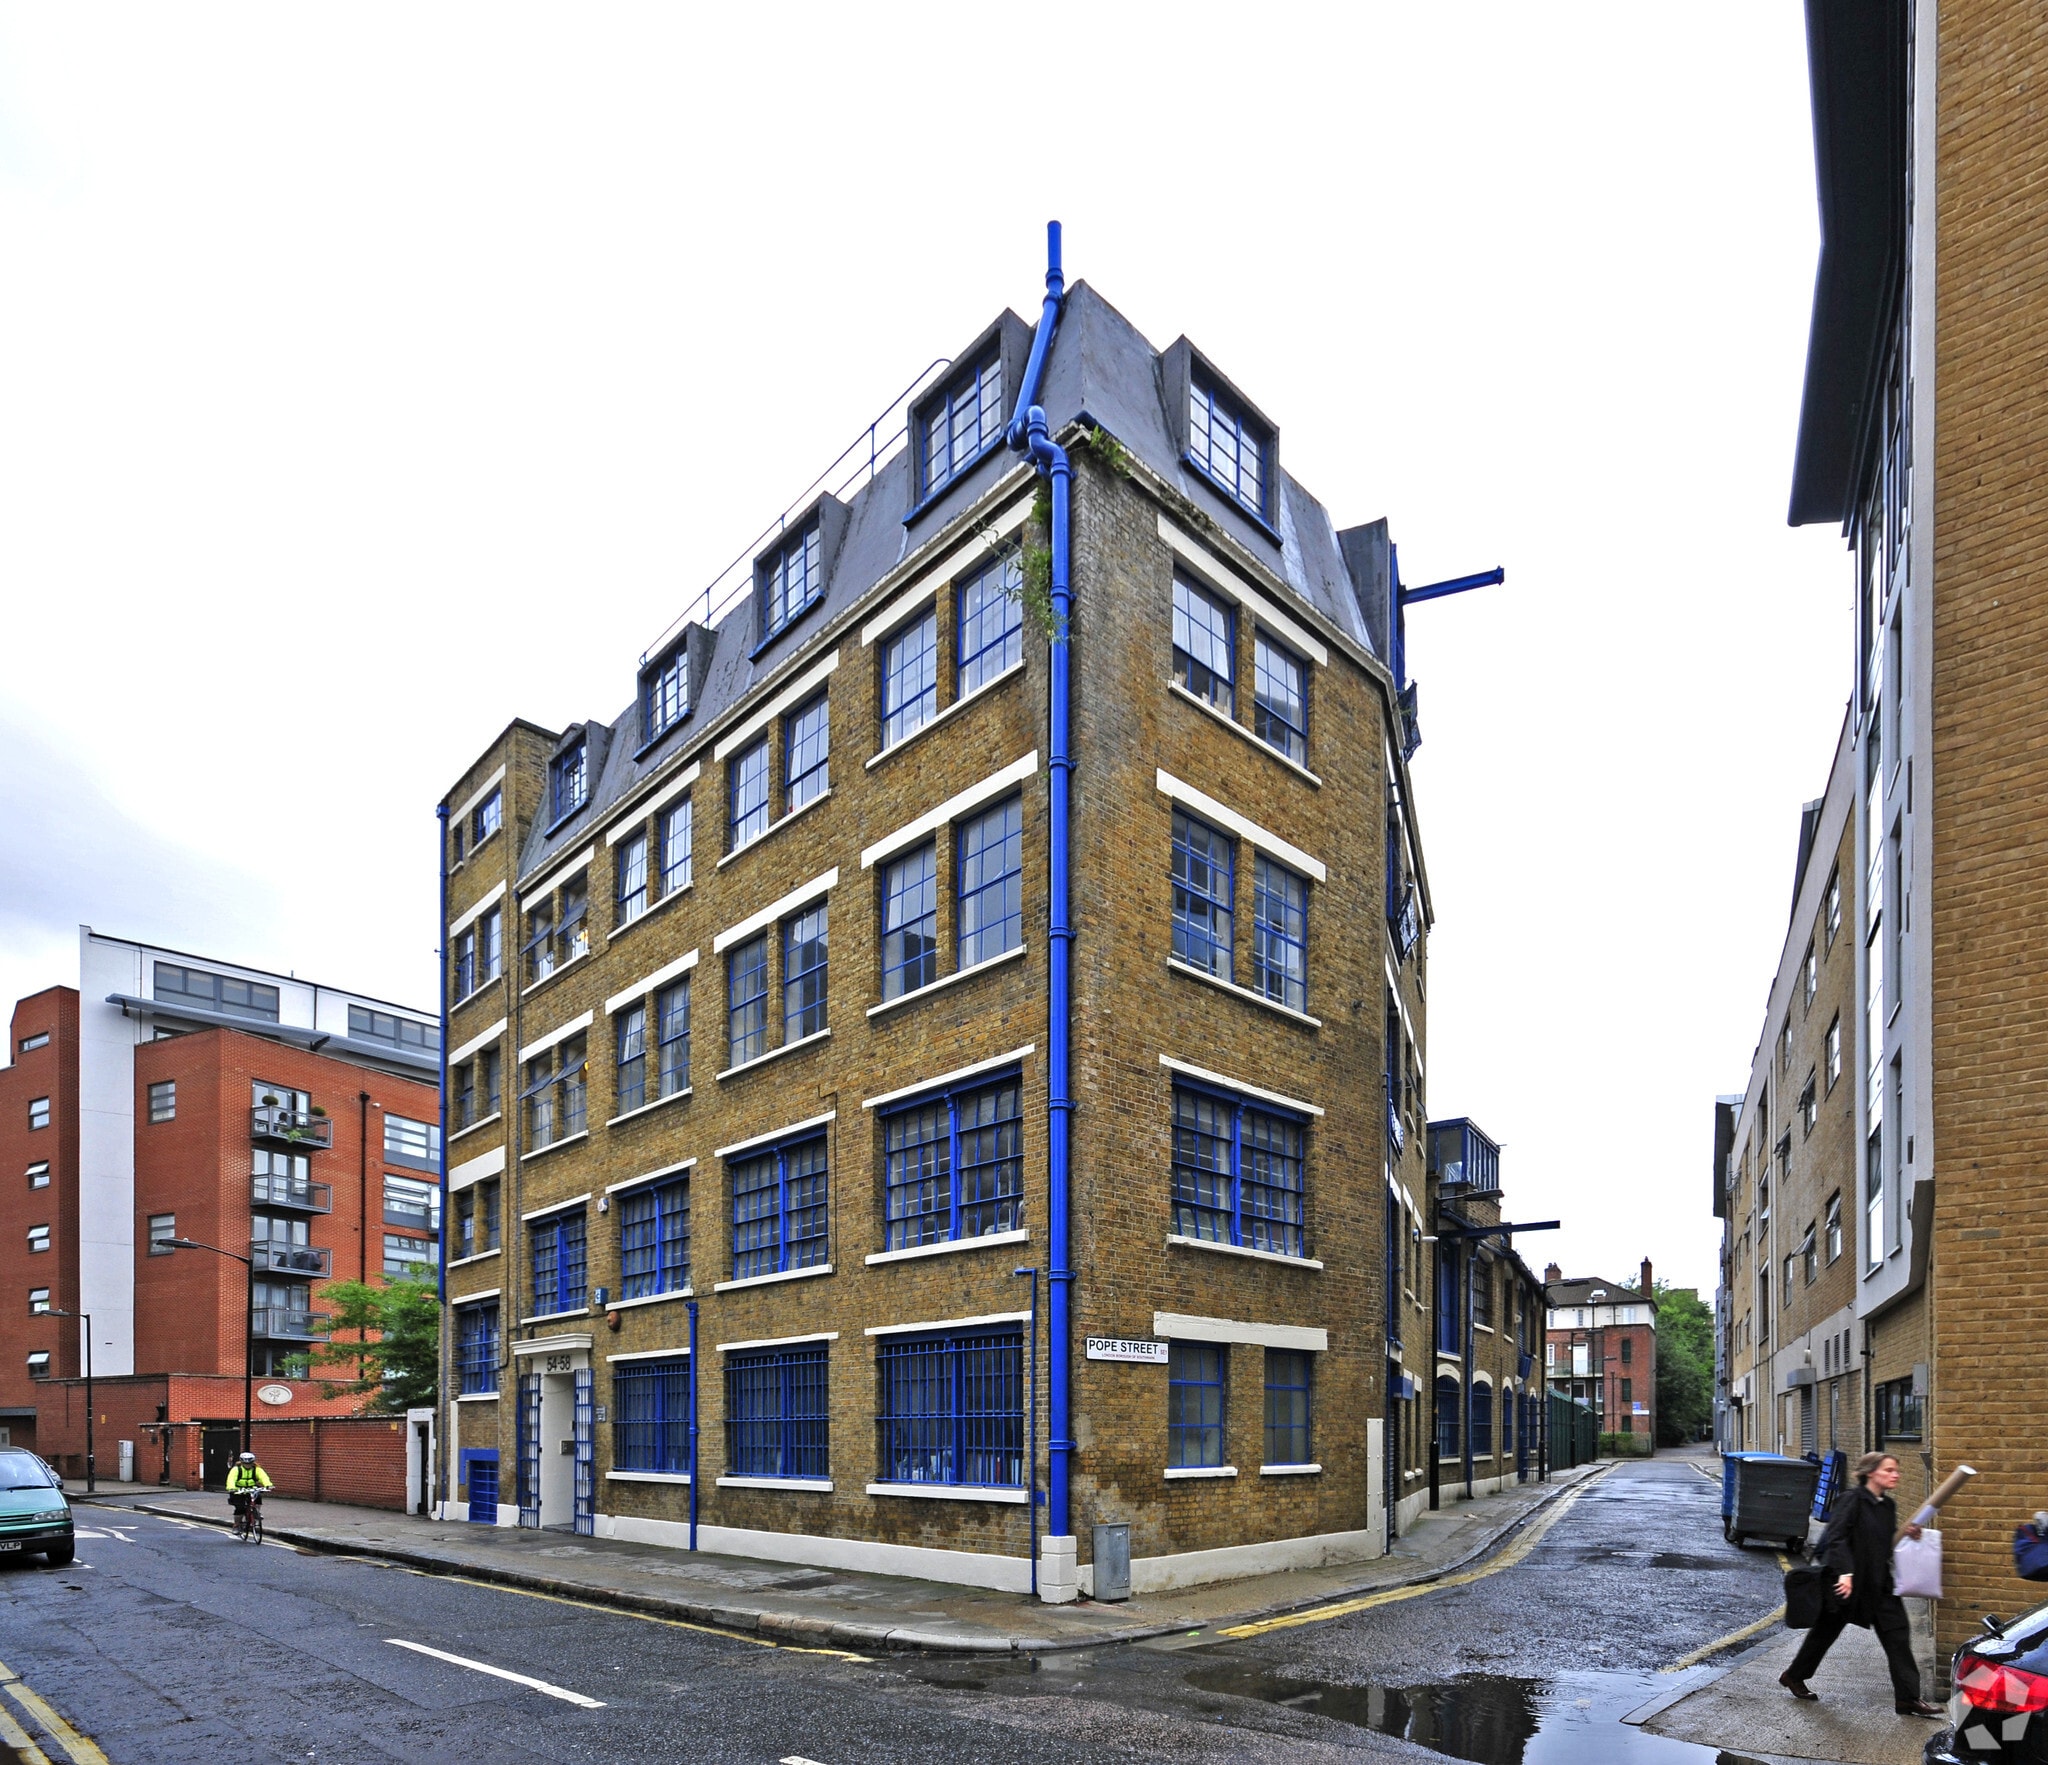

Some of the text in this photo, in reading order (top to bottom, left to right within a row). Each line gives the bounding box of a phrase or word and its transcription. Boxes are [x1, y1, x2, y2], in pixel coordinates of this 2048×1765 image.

[1089, 1340, 1158, 1354] POPE STREET
[547, 1355, 571, 1371] 54-58
